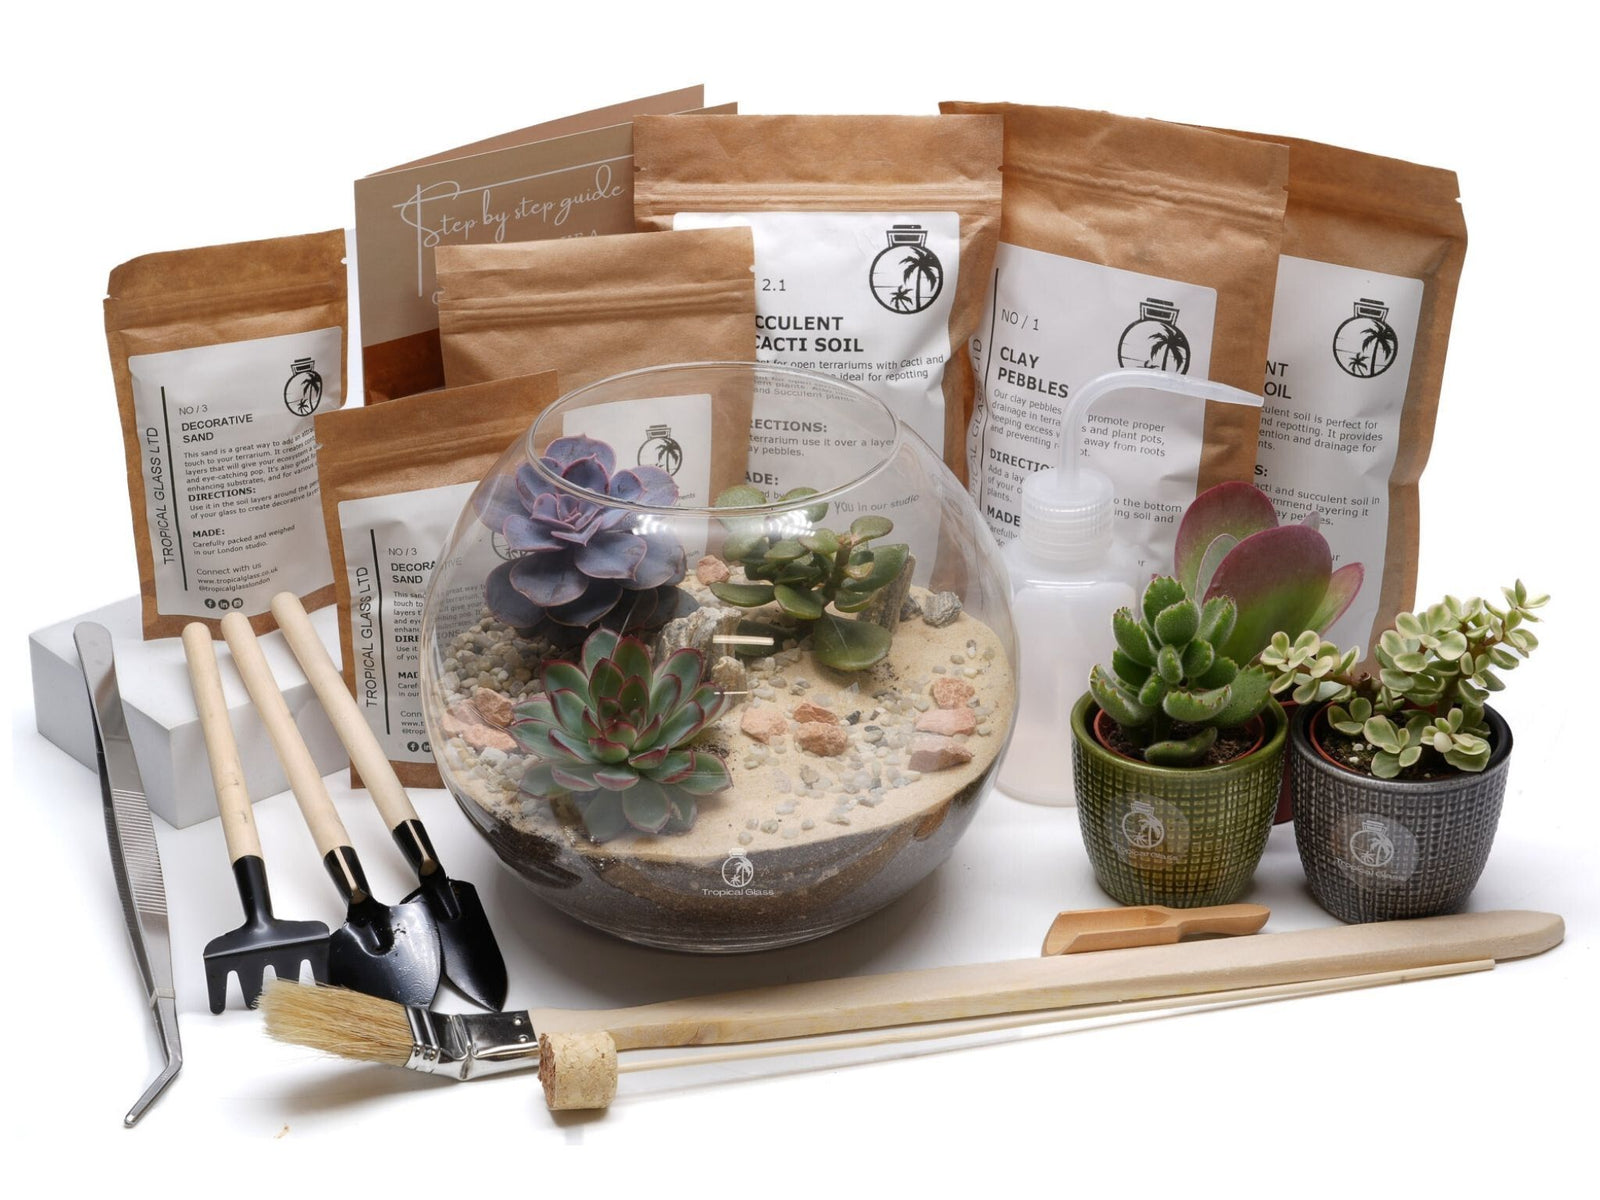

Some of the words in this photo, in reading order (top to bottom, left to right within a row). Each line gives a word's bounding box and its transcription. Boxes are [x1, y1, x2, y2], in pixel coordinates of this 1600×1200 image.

[401, 180, 478, 248] Step
[482, 189, 509, 243] by
[515, 197, 557, 225] step
[554, 164, 625, 226] guide
[762, 278, 786, 292] 2.1
[755, 315, 844, 331] CCULENT
[1001, 308, 1019, 325] NO
[1033, 319, 1039, 331] 1
[815, 338, 864, 352] SOIL
[819, 360, 873, 370] terrariums
[876, 359, 898, 370] with
[900, 356, 923, 368] Cacti
[926, 354, 944, 365] and
[1000, 346, 1039, 369] CLAY
[840, 370, 864, 381] ideal
[868, 370, 882, 381] for
[885, 368, 929, 382] repotting
[997, 367, 1069, 399] PEBBLES
[1264, 381, 1292, 399] OIL
[179, 406, 194, 416] NO
[202, 404, 208, 412] 3
[992, 401, 1027, 418] drainage
[1029, 410, 1038, 420] in
[994, 388, 1008, 399] Our
[1010, 393, 1027, 406] clay
[1029, 400, 1062, 415] pebbles
[1088, 414, 1129, 427] promote
[1132, 421, 1166, 433] proper
[181, 413, 253, 432] DECORATIVE
[750, 419, 828, 433] ECTIONS:
[991, 412, 1022, 430] keeping
[1024, 423, 1054, 437] excess
[1293, 411, 1311, 422] soil
[1314, 415, 1322, 424] is
[1326, 418, 1361, 430] perfect
[1364, 420, 1378, 430] for
[146, 427, 159, 454] LTD
[182, 432, 214, 444] SAND
[990, 424, 1004, 435] and
[1006, 429, 1052, 450] preventing
[1090, 426, 1109, 436] and
[1112, 429, 1137, 440] plant
[1140, 433, 1165, 446] pots,
[1276, 421, 1323, 437] repotting.
[1328, 429, 1336, 438] It
[1339, 431, 1383, 442] provides
[184, 451, 199, 459] This
[201, 448, 218, 458] sand
[220, 447, 226, 455] is
[235, 444, 254, 455] great
[256, 442, 270, 450] way
[802, 437, 820, 446] use
[824, 436, 831, 446] it
[834, 439, 856, 447] over
[1084, 438, 1110, 449] away
[1113, 440, 1137, 452] from
[1140, 446, 1166, 457] roots
[1293, 436, 1311, 446] and
[1314, 439, 1359, 454] drainage
[1362, 443, 1377, 453] for
[184, 458, 205, 467] touch
[217, 456, 233, 465] your
[235, 450, 271, 462] terrarium.
[274, 448, 280, 456] It
[762, 446, 805, 457] pebbles.
[185, 466, 208, 476] layers
[210, 465, 225, 473] that
[227, 462, 239, 471] will
[241, 461, 257, 470] give
[259, 458, 275, 468] your
[186, 475, 200, 484] and
[202, 470, 248, 483] eye-catching
[250, 468, 264, 478] pop.
[267, 465, 279, 473] It's
[280, 463, 294, 472] also
[988, 464, 1002, 476] Add
[150, 455, 165, 501] GLASS
[187, 482, 225, 493] enhancing
[268, 473, 281, 482] and
[282, 471, 292, 479] for
[745, 471, 779, 486] ADE:
[997, 481, 1014, 492] your
[188, 486, 256, 502] DIRECTIONS:
[222, 500, 234, 508] the
[236, 498, 249, 506] soil
[251, 495, 272, 505] layers
[273, 489, 297, 499] around
[298, 484, 308, 492] the
[858, 501, 868, 512] in
[870, 503, 887, 511] our
[890, 494, 920, 509] studio
[1275, 487, 1294, 497] and
[1297, 490, 1347, 505] succulent
[1351, 496, 1369, 506] soil
[1372, 496, 1380, 505] in
[190, 512, 198, 520] of
[200, 511, 216, 520] your
[218, 508, 237, 517] glass
[248, 502, 270, 512] create
[271, 495, 306, 509] decorative
[1123, 497, 1141, 508] the
[1143, 500, 1182, 513] bottom
[1316, 503, 1358, 518] layering
[1362, 508, 1368, 517] it
[1133, 510, 1151, 520] soil
[1154, 514, 1174, 524] and
[154, 505, 175, 565] TROPICAL
[192, 528, 225, 538] MADE:
[192, 538, 225, 548] Carefully
[228, 535, 252, 545] packed
[254, 532, 267, 540] and
[268, 524, 295, 536] weighed
[217, 545, 243, 555] London
[388, 548, 403, 556] NO
[196, 567, 231, 576] Connect
[232, 565, 250, 573] with
[392, 575, 423, 584] SAND
[356, 567, 371, 593] LTD
[360, 595, 373, 639] GLASS
[361, 642, 377, 707] TROPICAL
[702, 888, 743, 897] Tropical
[745, 888, 774, 896] Glass
